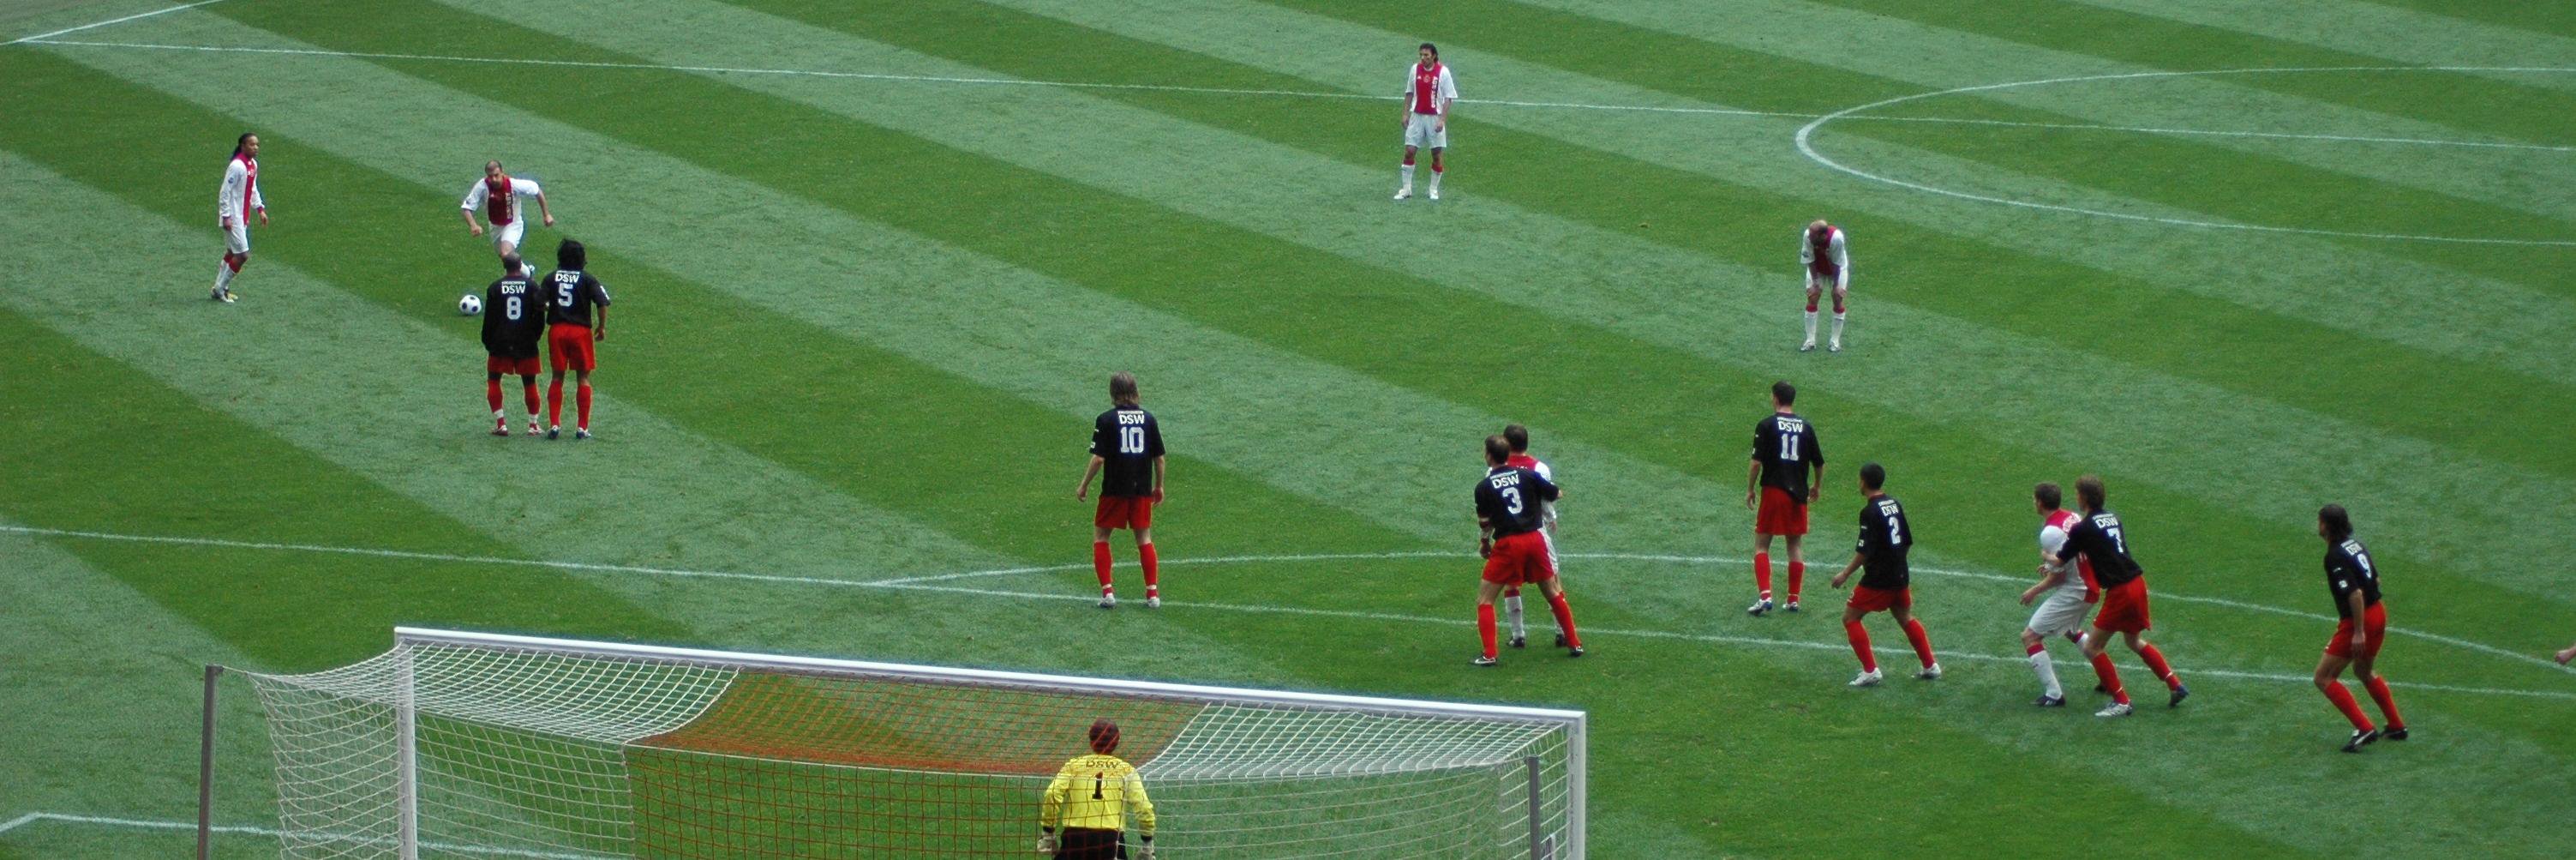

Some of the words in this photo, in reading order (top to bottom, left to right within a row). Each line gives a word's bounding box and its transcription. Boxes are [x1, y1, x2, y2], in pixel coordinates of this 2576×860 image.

[502, 284, 525, 294] DSW
[554, 273, 579, 283] DSW
[558, 283, 573, 307] 5
[506, 296, 522, 320] 8
[1118, 414, 1145, 425] DSW
[1777, 420, 1803, 433] DSW
[1120, 426, 1145, 454] 10
[1781, 433, 1799, 461] 11
[1491, 473, 1519, 489] DSW
[1502, 486, 1523, 514] 3
[1889, 516, 1901, 544] 2
[2094, 516, 2118, 529] DSW
[2106, 527, 2124, 553] 7
[1091, 771, 1104, 801] 1
